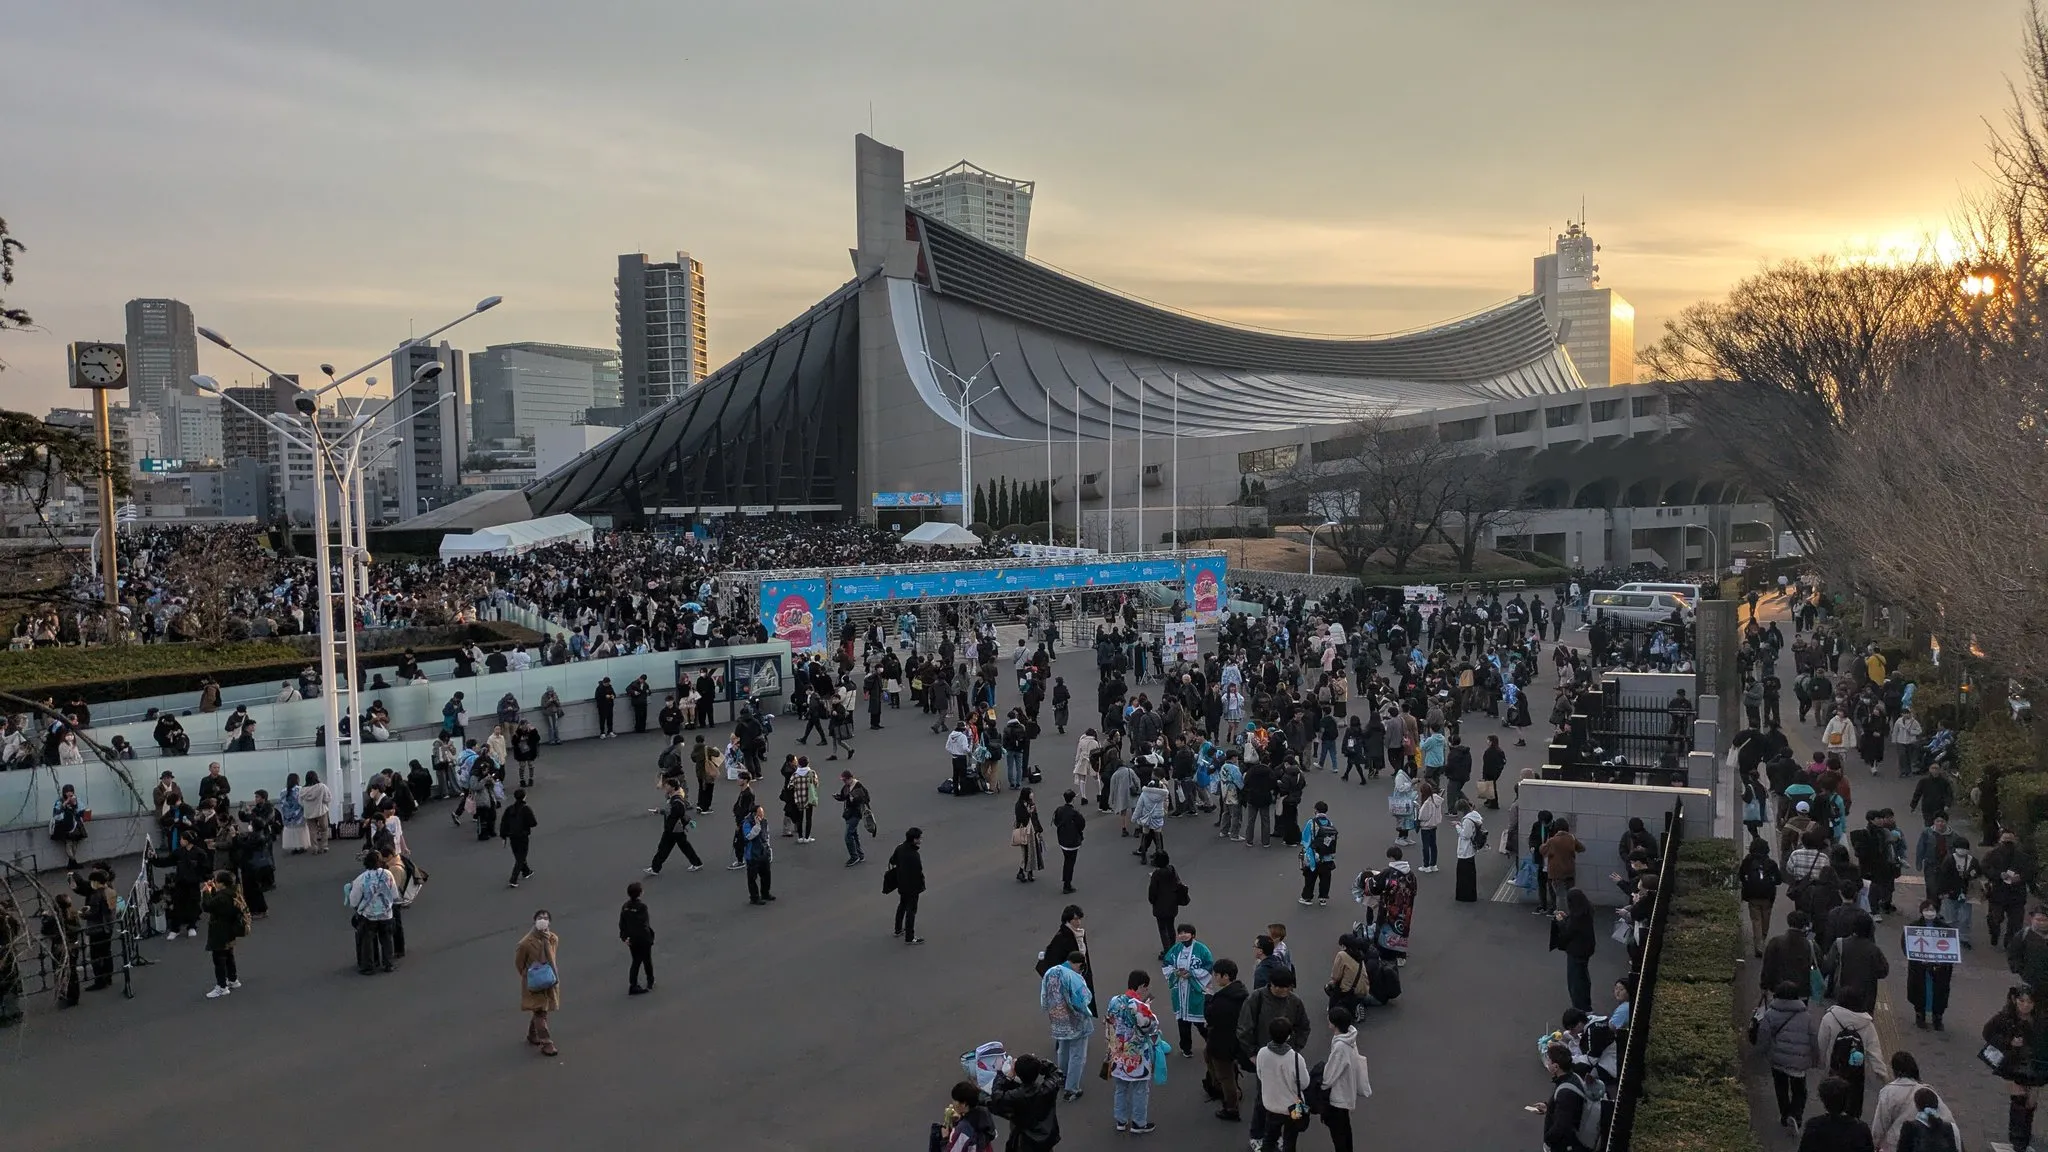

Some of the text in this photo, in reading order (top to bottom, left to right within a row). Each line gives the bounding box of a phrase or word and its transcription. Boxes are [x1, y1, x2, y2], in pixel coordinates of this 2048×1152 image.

[152, 460, 182, 470] ニトリ
[1915, 929, 1947, 938] 左側通行
